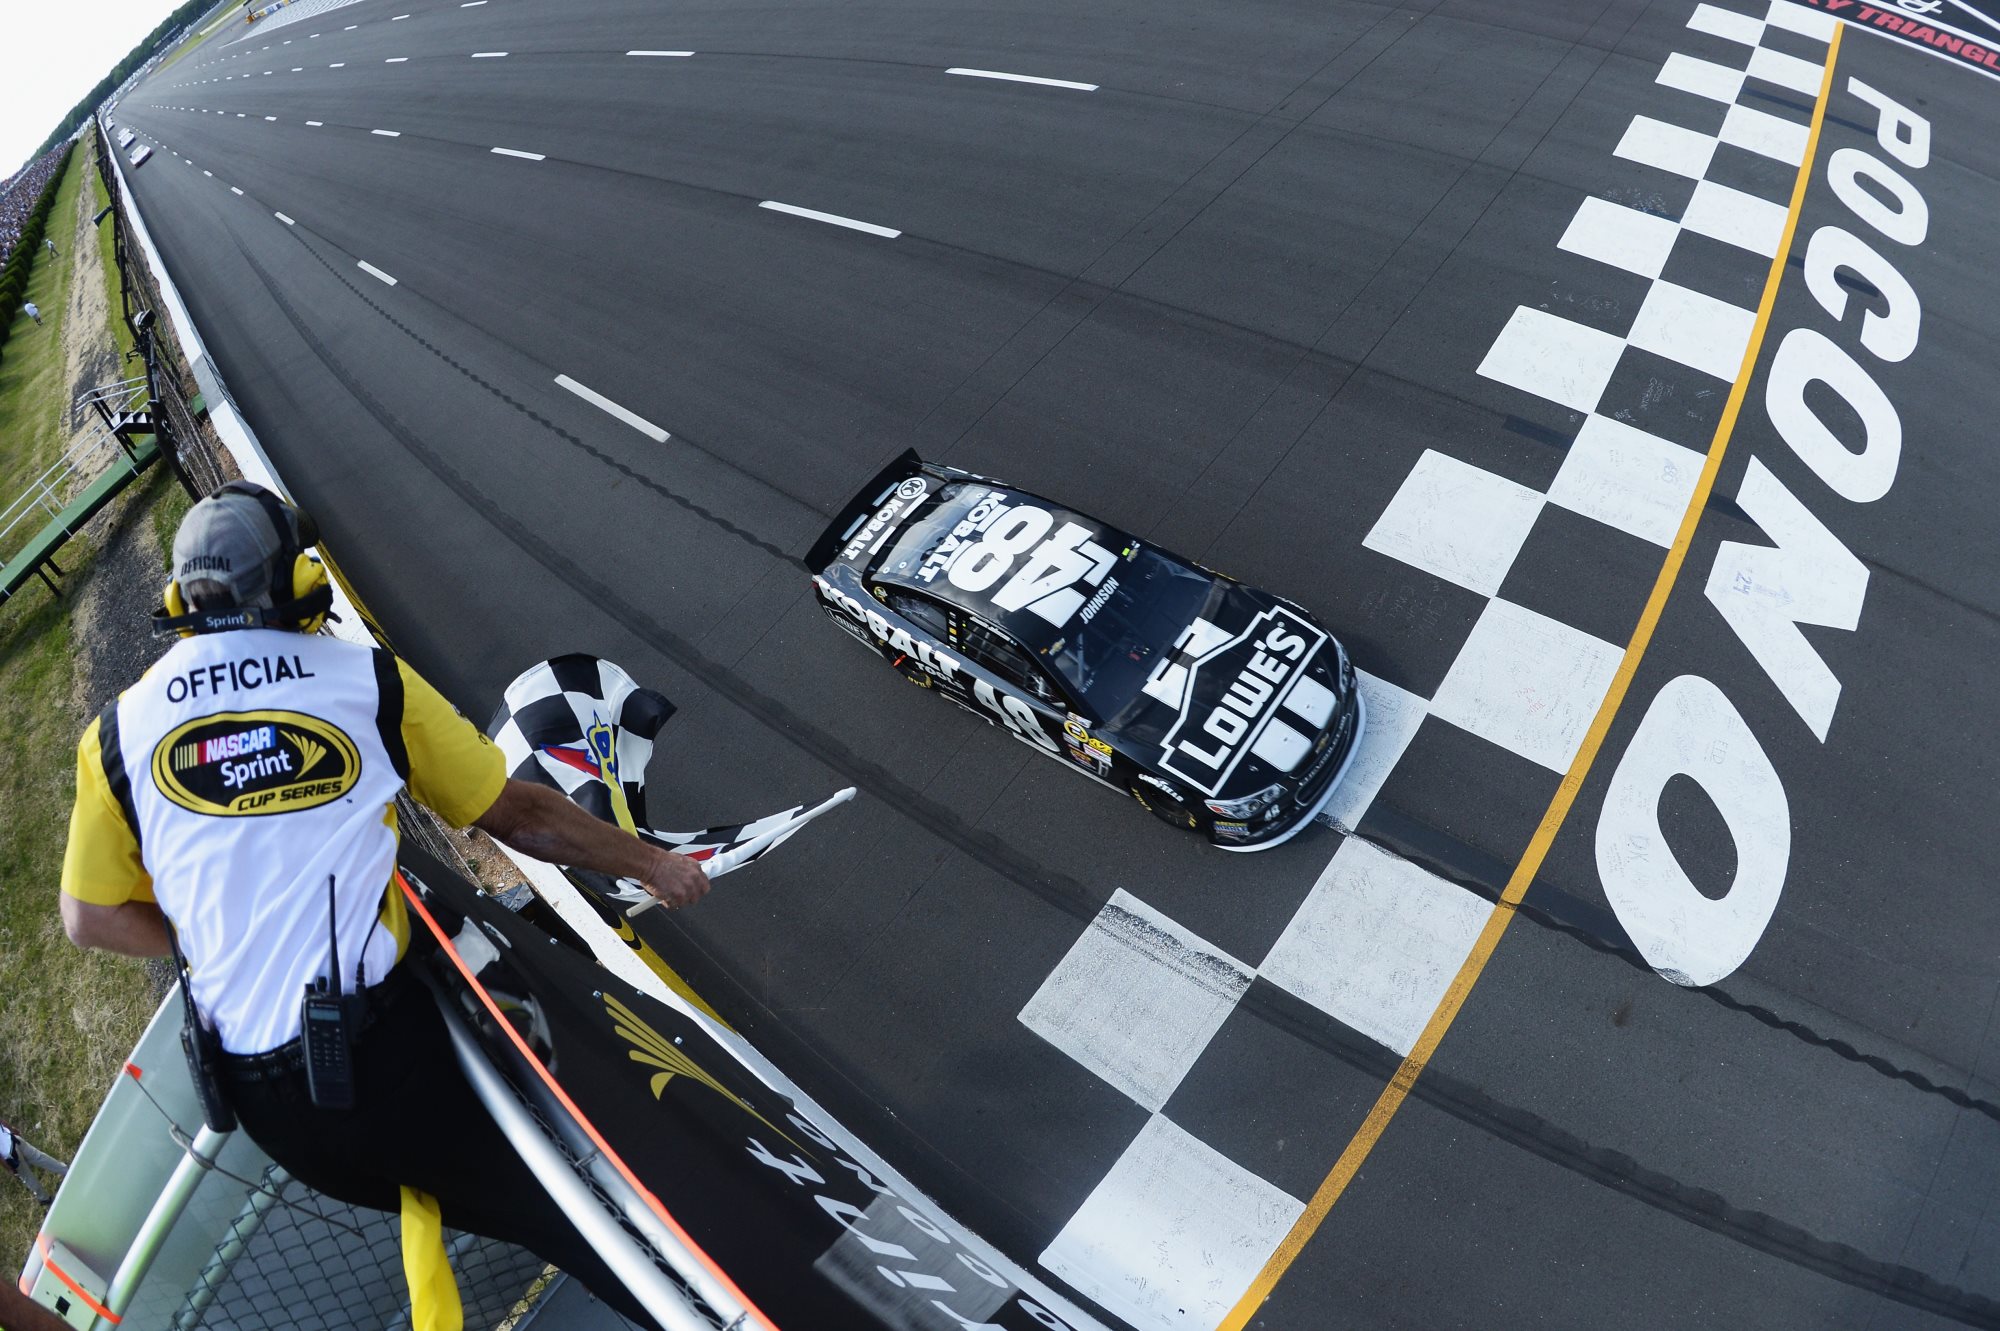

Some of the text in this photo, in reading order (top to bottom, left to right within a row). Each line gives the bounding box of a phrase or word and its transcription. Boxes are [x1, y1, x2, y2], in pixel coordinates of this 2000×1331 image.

[843, 498, 904, 561] KOBALT
[916, 491, 1008, 583] KOBALT
[1595, 76, 1931, 987] POCONO
[181, 555, 233, 577] OFFICIAL
[948, 505, 1100, 614] 48
[206, 613, 245, 628] Sprint
[1079, 576, 1120, 625] JOHNSON
[818, 580, 961, 679] KOBALT
[167, 655, 315, 703] OFFICIAL
[915, 661, 966, 690] TOOLS
[1178, 626, 1307, 771] LOWE'S
[973, 678, 1060, 753] 48
[206, 726, 271, 763] NASCAR
[220, 749, 293, 789] Sprint
[237, 781, 343, 811] CUP SERIES
